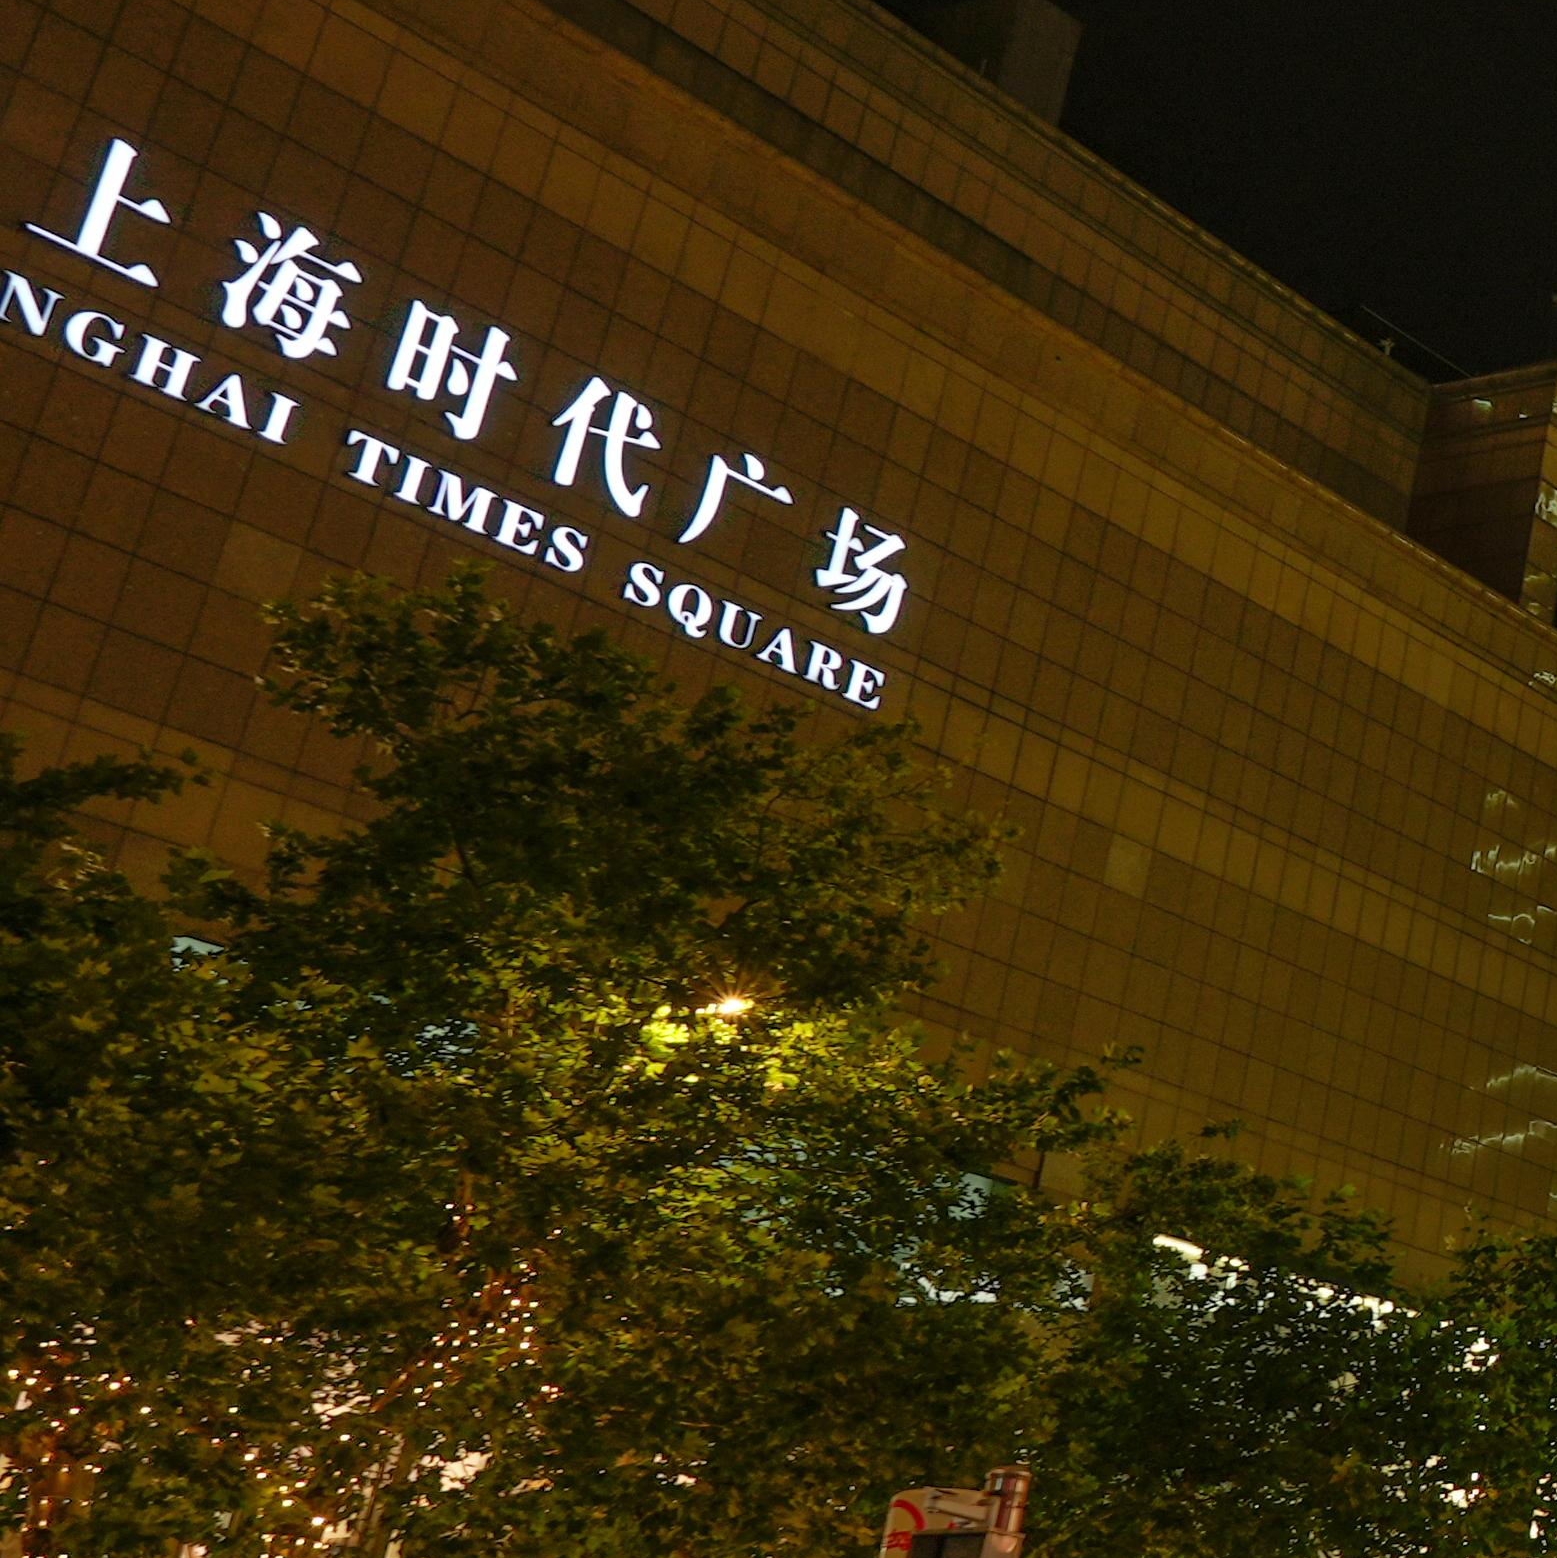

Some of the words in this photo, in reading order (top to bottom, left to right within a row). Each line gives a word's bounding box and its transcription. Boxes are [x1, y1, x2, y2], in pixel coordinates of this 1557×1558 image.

[25, 138, 907, 634] 上海时代广场
[345, 430, 590, 573] TIMES
[622, 563, 888, 711] SQUARE
